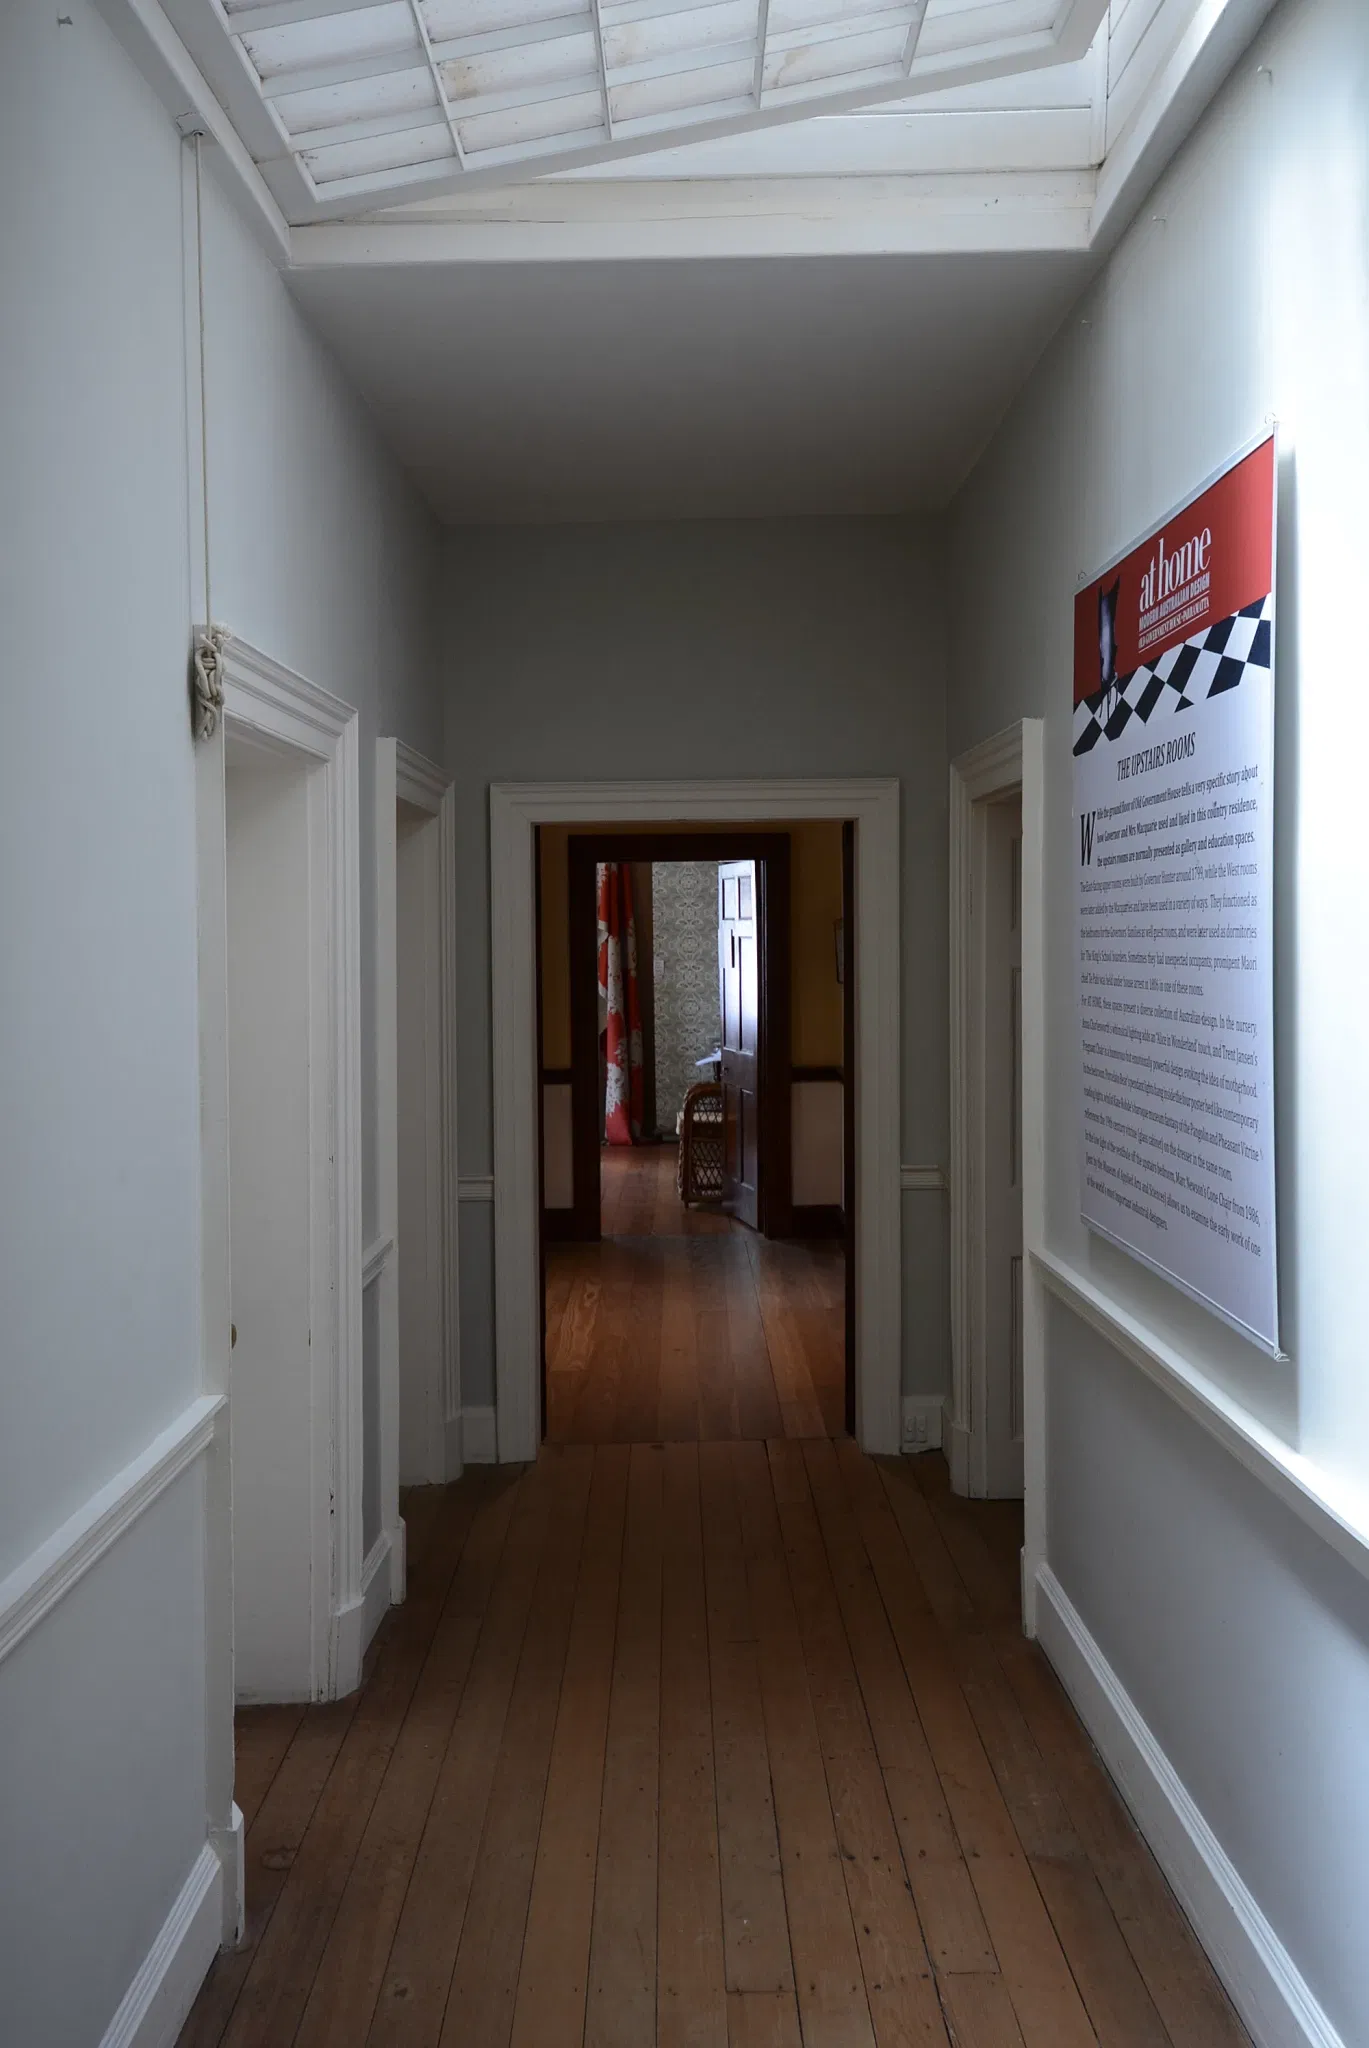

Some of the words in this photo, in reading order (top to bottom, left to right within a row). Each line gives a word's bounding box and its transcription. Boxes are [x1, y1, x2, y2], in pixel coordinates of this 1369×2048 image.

[1139, 557, 1156, 613] at
[1156, 527, 1212, 604] home
[1138, 608, 1158, 631] MODERN
[1159, 590, 1189, 621] AUSTRALIAN
[1190, 572, 1210, 598] DESIGN
[1117, 756, 1130, 781] THE
[1131, 743, 1165, 776] UPSTAIRS
[1166, 731, 1195, 764] ROOMS
[1142, 788, 1166, 807] Government
[1167, 787, 1181, 801] House
[1181, 782, 1191, 797] tells
[1191, 783, 1194, 794] a
[1195, 780, 1205, 795] very
[1206, 772, 1225, 793] specific
[1226, 769, 1240, 786] story
[1241, 762, 1258, 781] about
[1128, 824, 1136, 836] Mrs
[1136, 818, 1157, 836] Macquarie
[1158, 815, 1168, 830] used
[1169, 813, 1177, 828] and
[1178, 810, 1190, 826] lived
[1191, 809, 1195, 823] in
[1196, 807, 1206, 822] this
[1207, 803, 1227, 820] country
[1228, 798, 1258, 815] residence,
[1153, 842, 1174, 861] presented
[1181, 839, 1196, 857] gallery
[1197, 836, 1207, 851] and
[1208, 832, 1234, 849] education
[1234, 830, 1255, 848] spaces.
[1176, 867, 1191, 883] around
[1204, 864, 1217, 879] while
[1218, 863, 1226, 878] the
[1226, 861, 1239, 877] West
[1240, 862, 1257, 876] rooms
[1210, 894, 1221, 912] They
[1222, 891, 1250, 908] functioned
[1251, 894, 1257, 907] as
[1197, 924, 1207, 938] later
[1208, 923, 1219, 938] used
[1220, 927, 1225, 938] as
[1226, 923, 1257, 939] dormitories
[1213, 954, 1240, 972] prominent
[1241, 955, 1257, 971] Maori
[1176, 980, 1188, 995] these
[1179, 1008, 1200, 1025] Australian
[1219, 1014, 1225, 1029] In
[1225, 1015, 1234, 1030] the
[1235, 1020, 1257, 1038] nursery,
[1212, 1044, 1221, 1058] and
[1222, 1045, 1235, 1062] Trent
[1236, 1047, 1257, 1066] Jansen's
[1200, 1069, 1208, 1084] the
[1208, 1071, 1219, 1087] idea
[1219, 1074, 1225, 1089] of
[1222, 1107, 1258, 1134] contemporary
[1197, 1152, 1205, 1170] the
[1206, 1160, 1217, 1175] same
[1219, 1192, 1232, 1212] Chair
[1232, 1198, 1244, 1217] from
[1209, 1216, 1217, 1232] the
[1218, 1223, 1230, 1243] early
[1230, 1231, 1244, 1247] work
[1244, 1236, 1250, 1251] of
[1250, 1241, 1260, 1256] one
